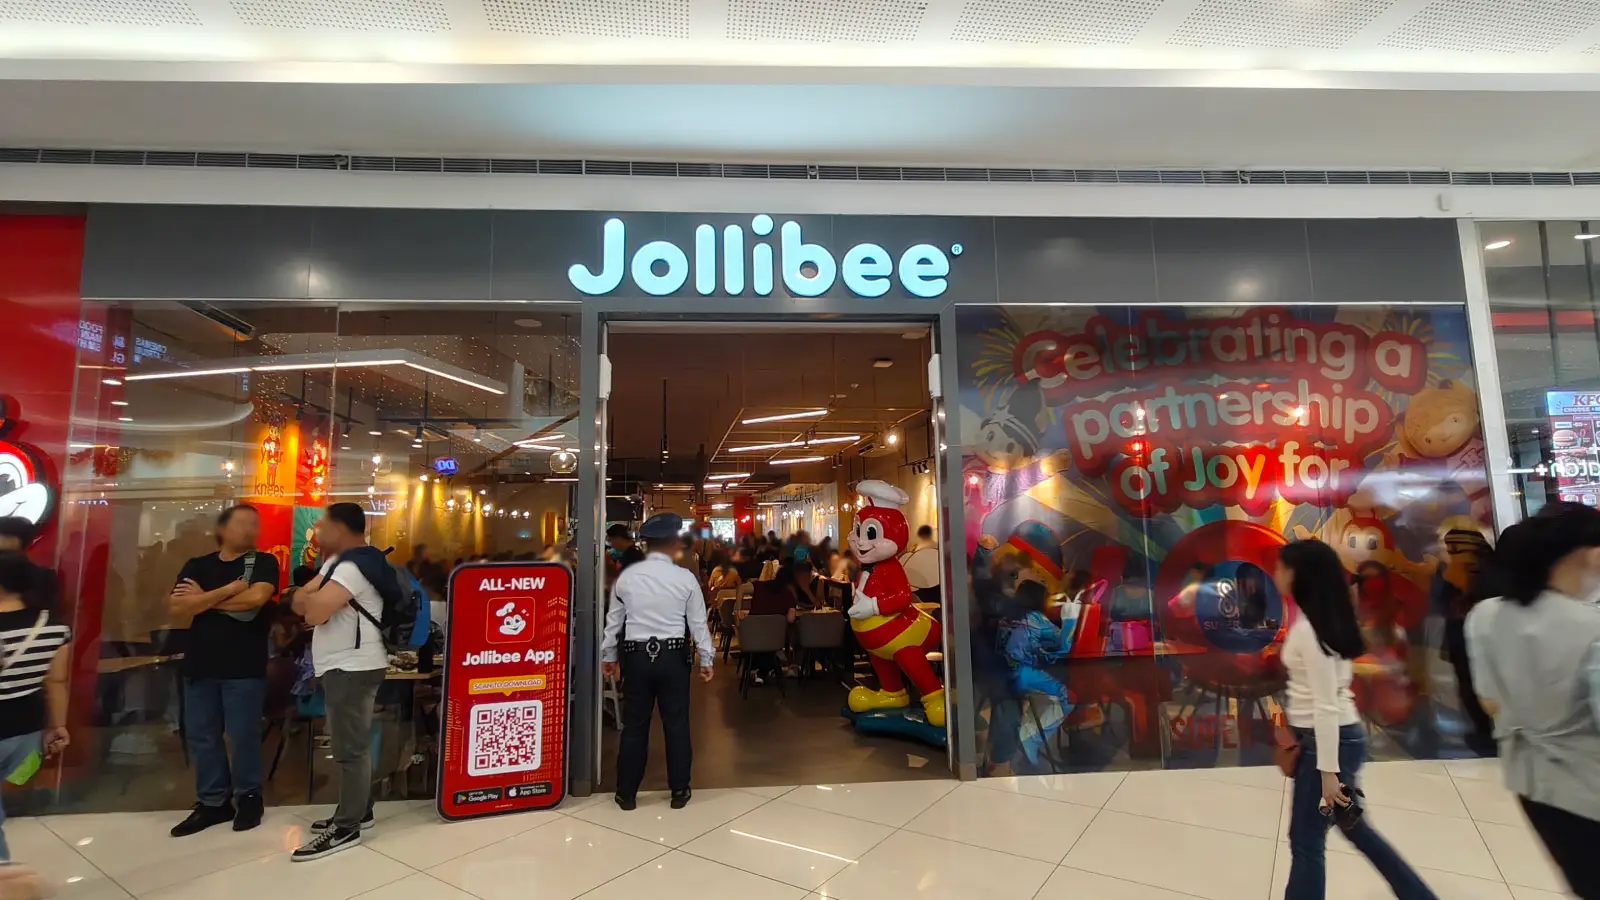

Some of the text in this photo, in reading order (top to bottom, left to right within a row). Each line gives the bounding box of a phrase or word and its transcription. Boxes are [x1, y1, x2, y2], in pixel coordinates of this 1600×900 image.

[568, 214, 950, 299] Jollibee
[1022, 313, 1412, 389] Celebrating a
[1072, 379, 1380, 460] partnership
[1120, 441, 1350, 501] of Joy for
[254, 476, 285, 498] knees
[479, 577, 546, 592] ALL-NEW
[462, 648, 555, 667] Jollibee App
[504, 679, 541, 687] DOWNLOAD
[468, 794, 488, 802] Google
